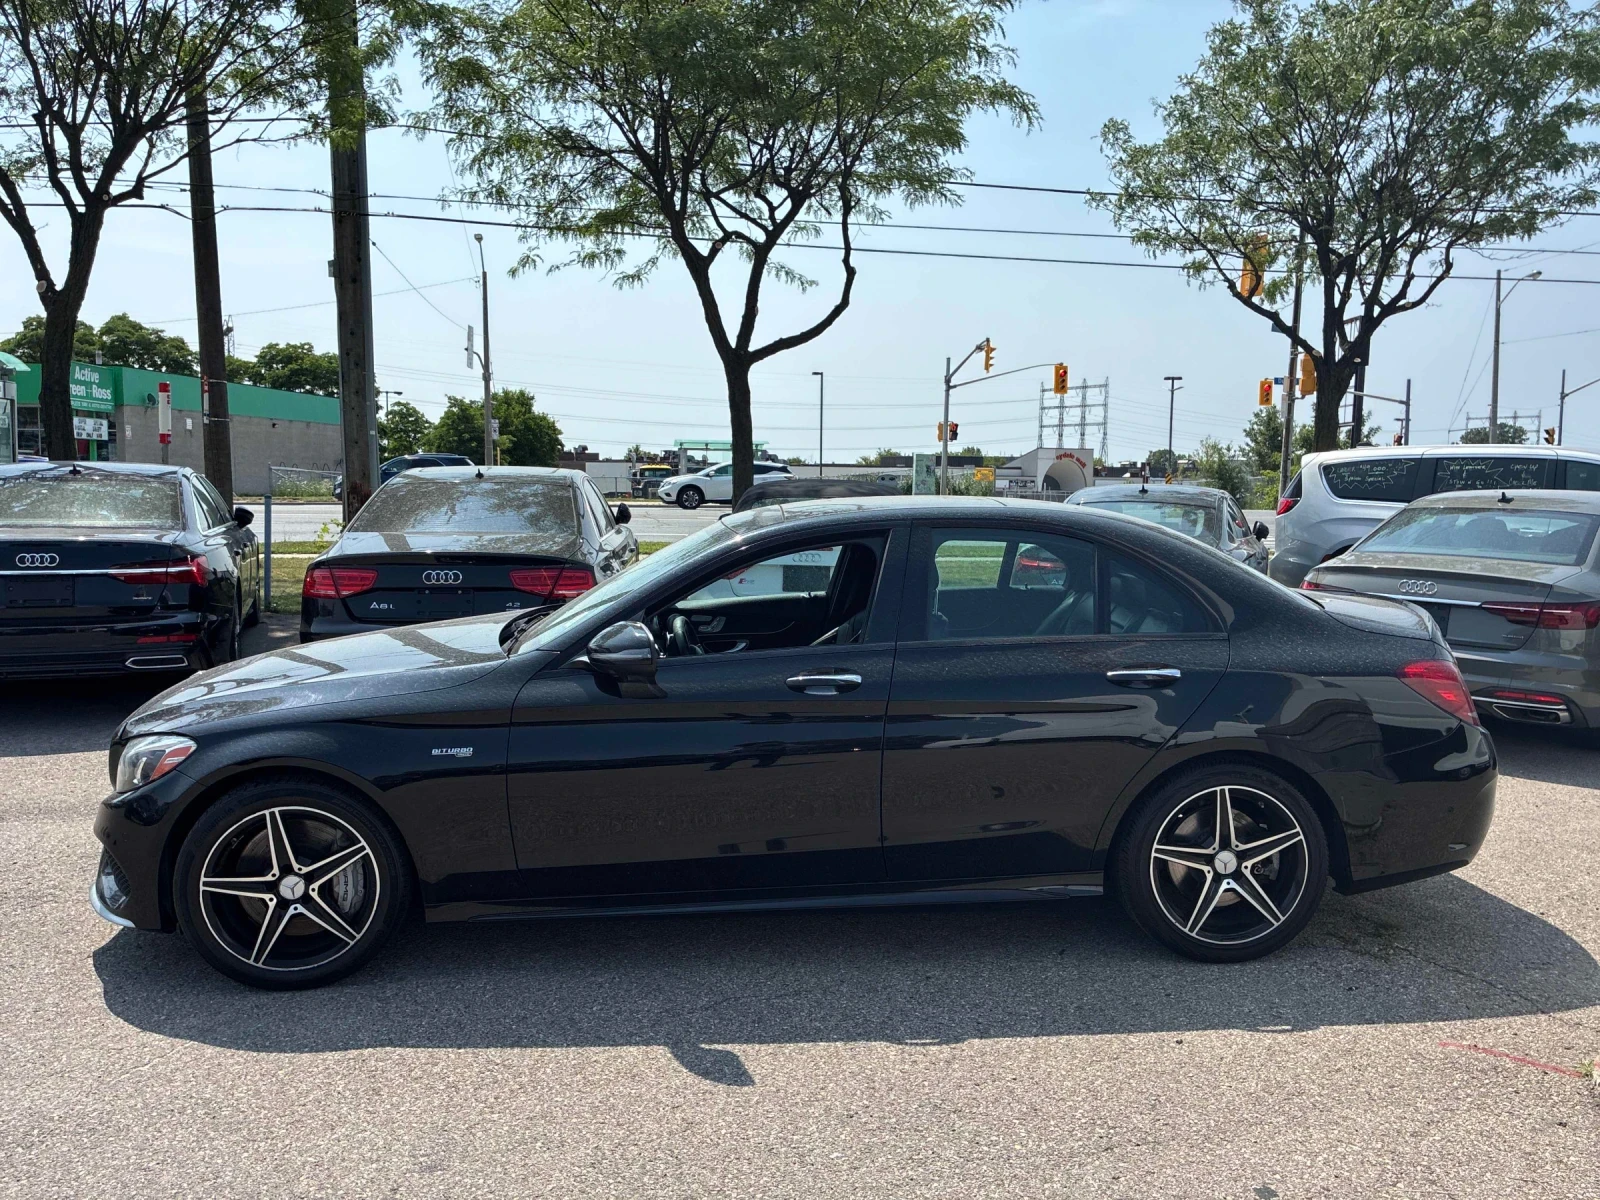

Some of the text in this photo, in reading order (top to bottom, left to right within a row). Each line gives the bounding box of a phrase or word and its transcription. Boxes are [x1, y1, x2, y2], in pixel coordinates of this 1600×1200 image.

[75, 366, 99, 383] Active
[70, 384, 86, 397] reen
[92, 385, 112, 399] Ross
